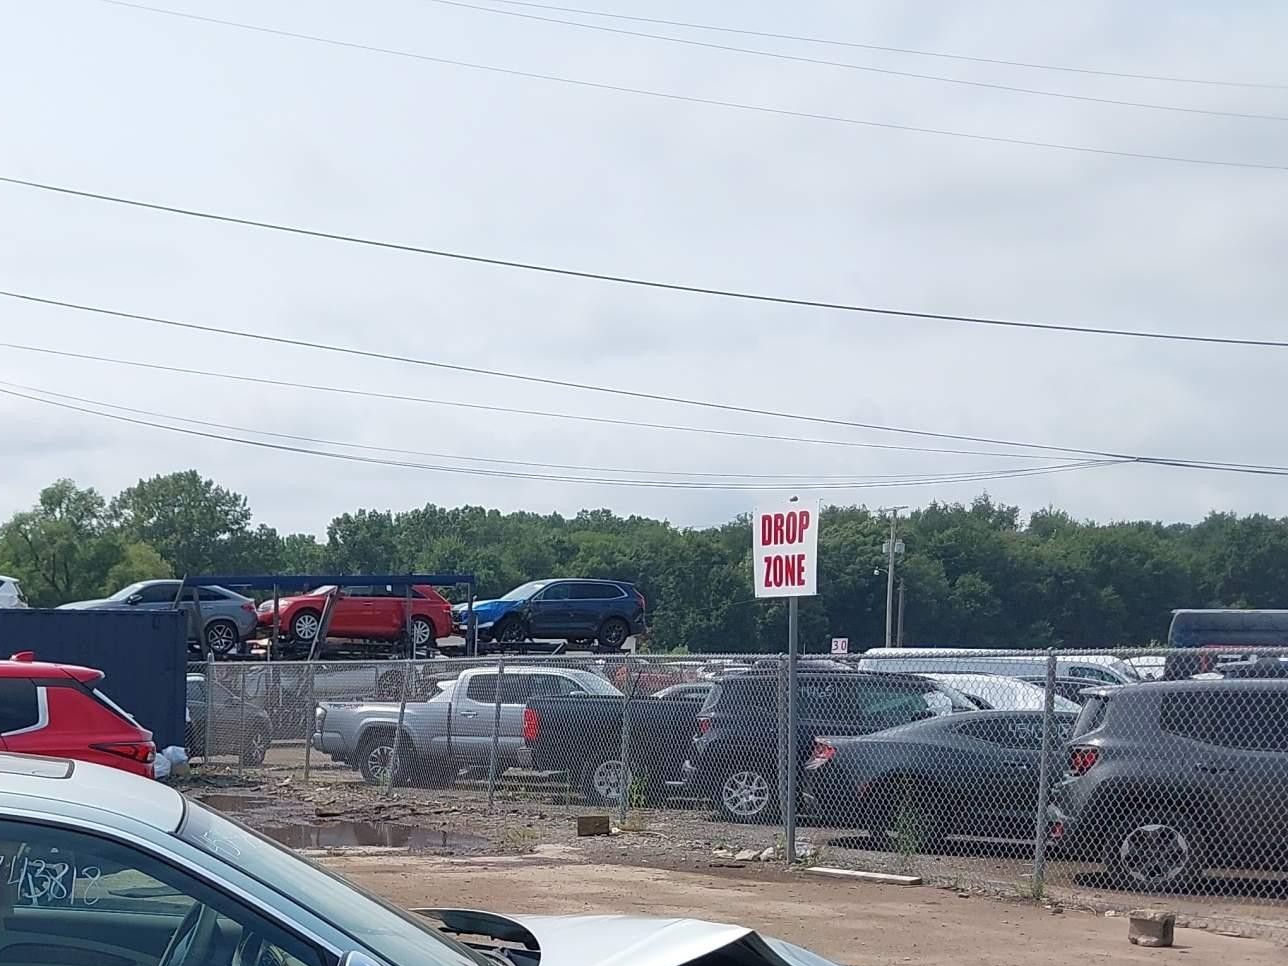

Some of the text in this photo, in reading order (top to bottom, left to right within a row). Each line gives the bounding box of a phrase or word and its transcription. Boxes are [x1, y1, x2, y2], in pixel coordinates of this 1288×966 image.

[761, 511, 810, 546] DROP
[764, 554, 806, 588] ZONE
[832, 640, 847, 651] 30
